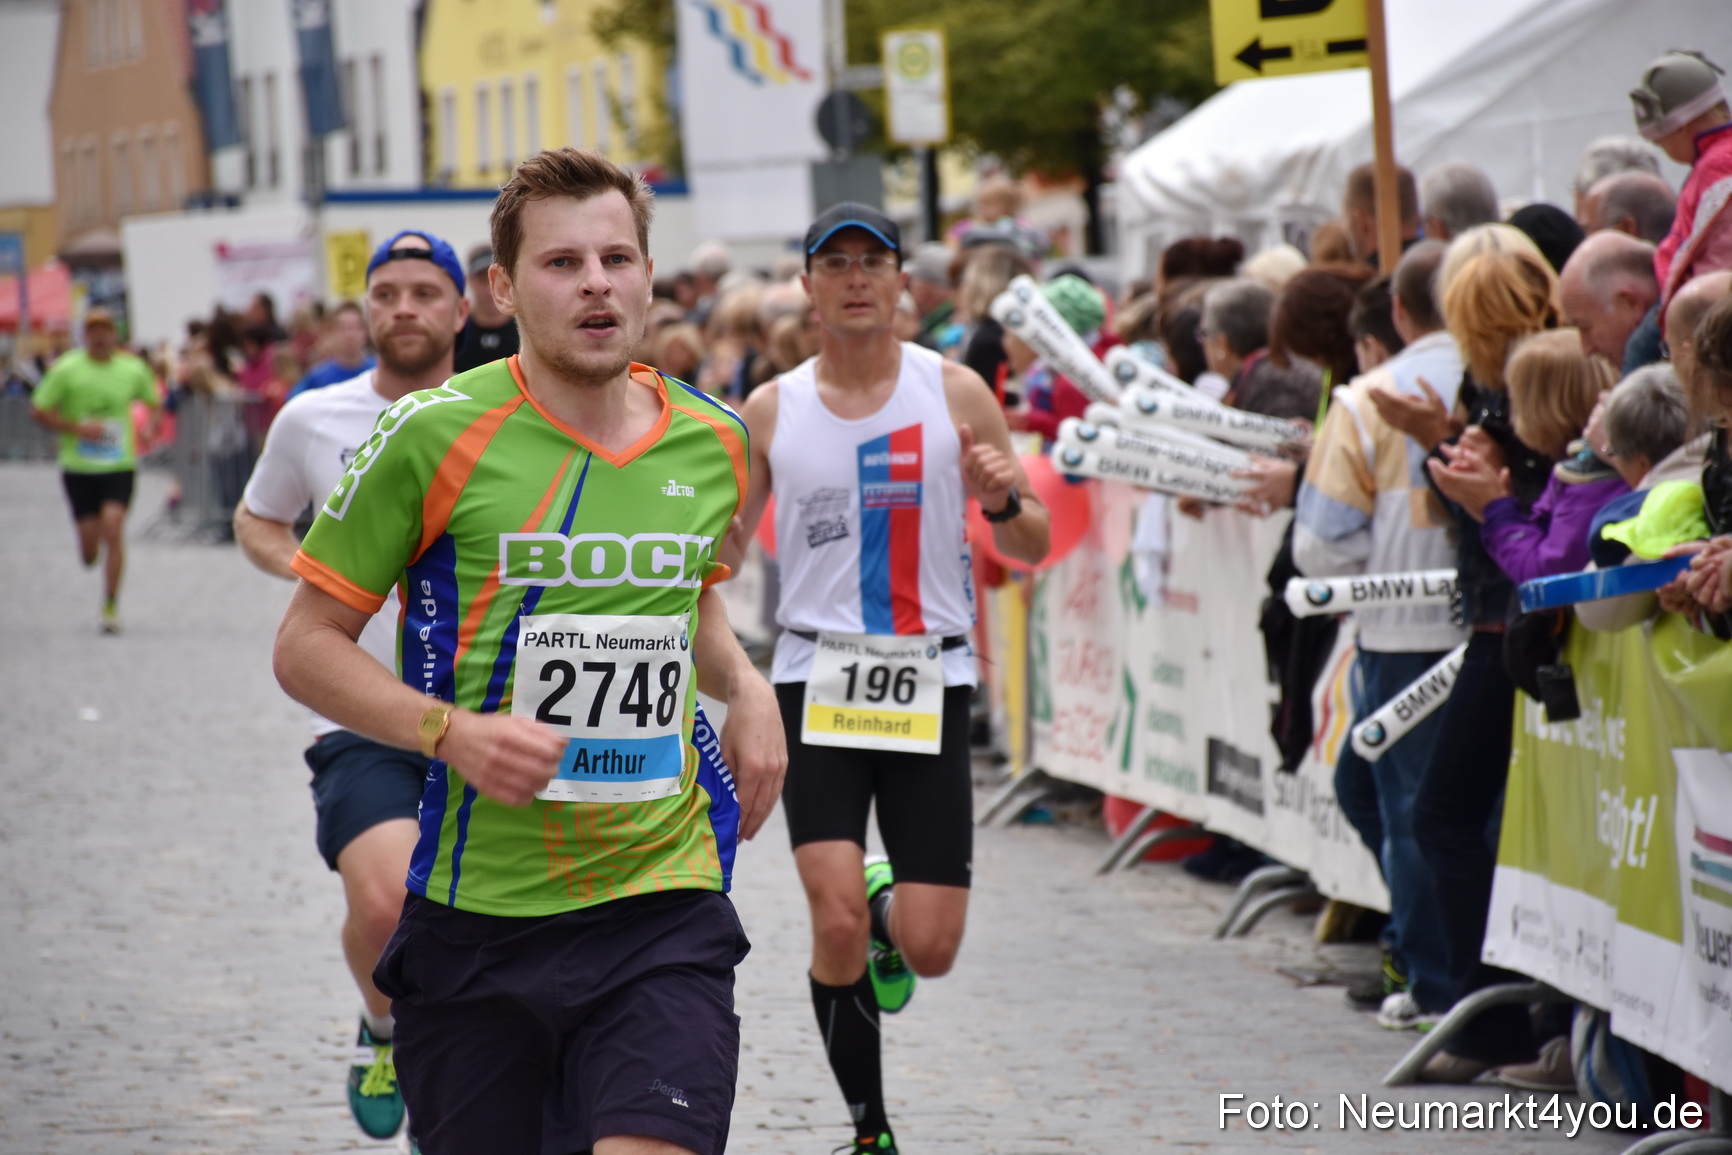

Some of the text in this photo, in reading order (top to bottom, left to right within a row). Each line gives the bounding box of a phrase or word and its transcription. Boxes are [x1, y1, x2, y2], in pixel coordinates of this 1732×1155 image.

[1350, 578, 1414, 602] BMW
[523, 631, 676, 651] PARTL Neumarkt
[819, 637, 862, 656] PARTL
[535, 659, 681, 727] 2748
[841, 662, 918, 705] 196
[1393, 673, 1449, 722] BMW
[833, 713, 911, 735] Reinhard
[572, 748, 646, 774] Arthur
